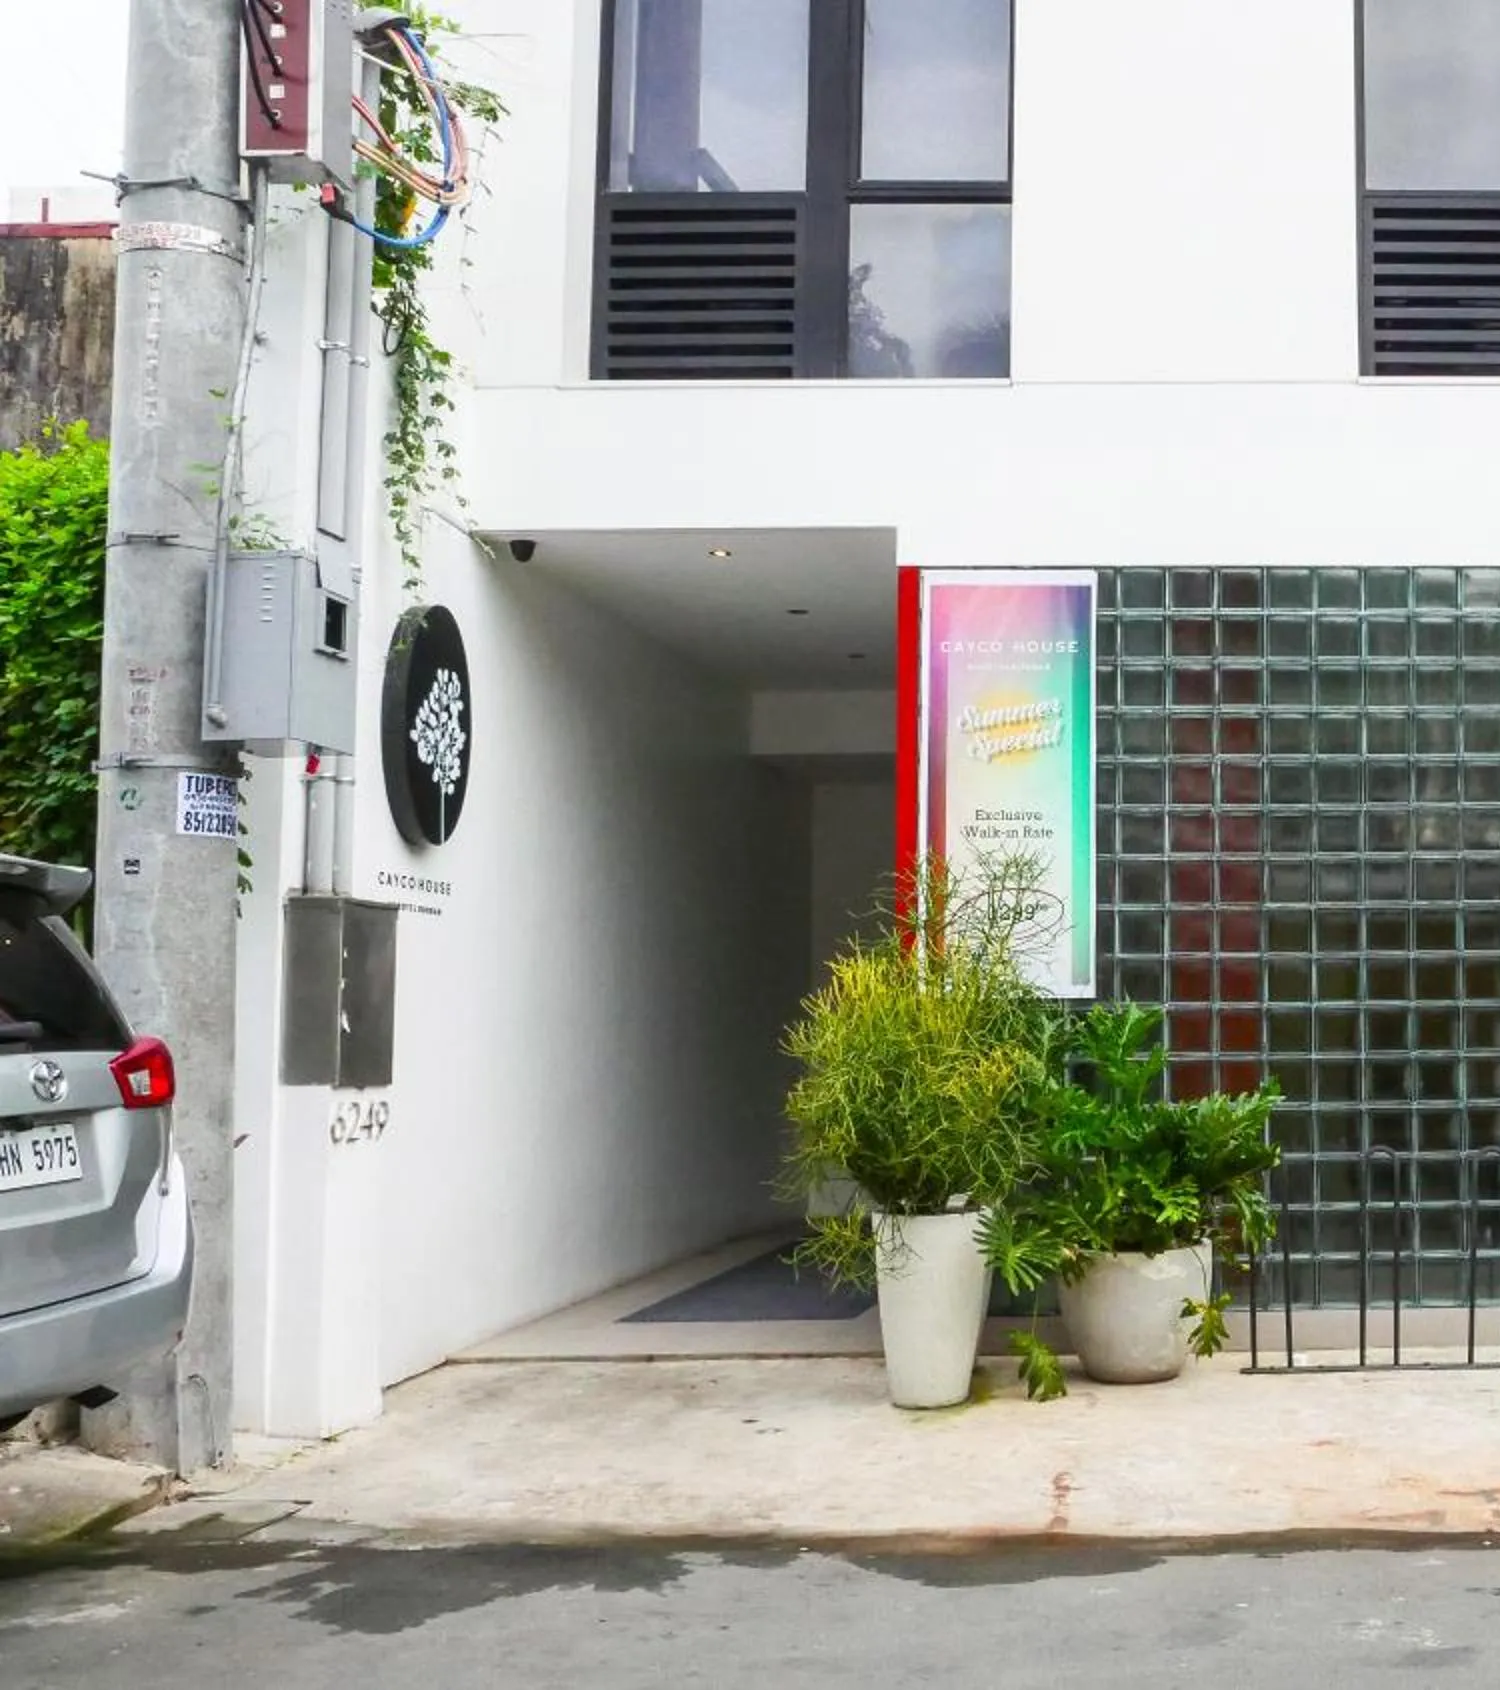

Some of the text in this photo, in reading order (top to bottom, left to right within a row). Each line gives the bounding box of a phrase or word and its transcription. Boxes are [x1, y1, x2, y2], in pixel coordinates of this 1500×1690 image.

[940, 640, 1080, 654] CAYCO HOUSE
[957, 698, 1062, 733] Summer
[967, 720, 1064, 764] Special
[975, 809, 1043, 821] Exclusive
[963, 825, 1054, 838] Walk-in Rate
[378, 871, 452, 896] CAYCO HOUSE
[330, 1101, 390, 1144] 6249
[32, 1136, 77, 1171] 5975
